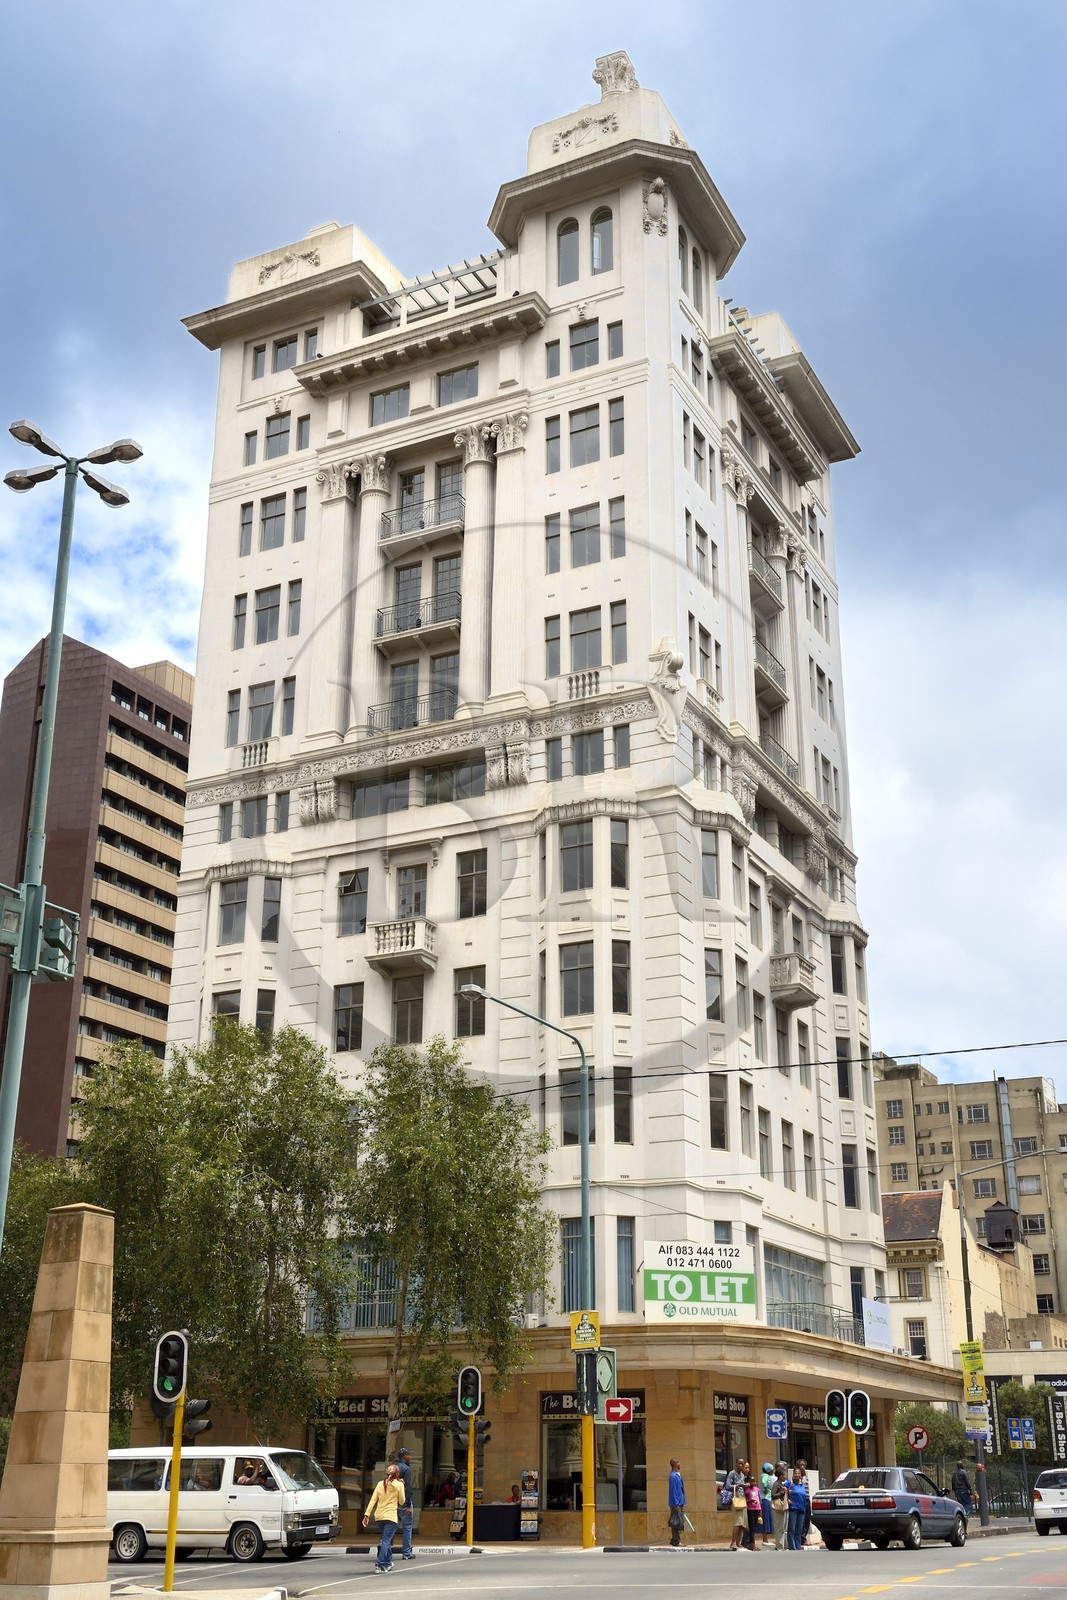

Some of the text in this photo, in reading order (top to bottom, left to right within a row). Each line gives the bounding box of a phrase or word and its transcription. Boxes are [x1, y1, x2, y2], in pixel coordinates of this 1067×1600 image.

[658, 1245, 740, 1257] Alf 083 444 1122
[666, 1257, 732, 1269] 012 471 0600
[651, 1274, 749, 1303] TO LET
[679, 1307, 738, 1317] OLD MUTUAL
[339, 1400, 366, 1413] Bed
[371, 1399, 408, 1414] Shp
[543, 1395, 560, 1411] The
[715, 1395, 746, 1415] Bed Shop
[799, 1406, 811, 1420] Bed
[812, 1407, 826, 1421] Sho
[1055, 1411, 1066, 1431] Bed
[772, 1424, 782, 1437] R
[914, 1431, 924, 1445] P
[1057, 1433, 1067, 1460] Shop
